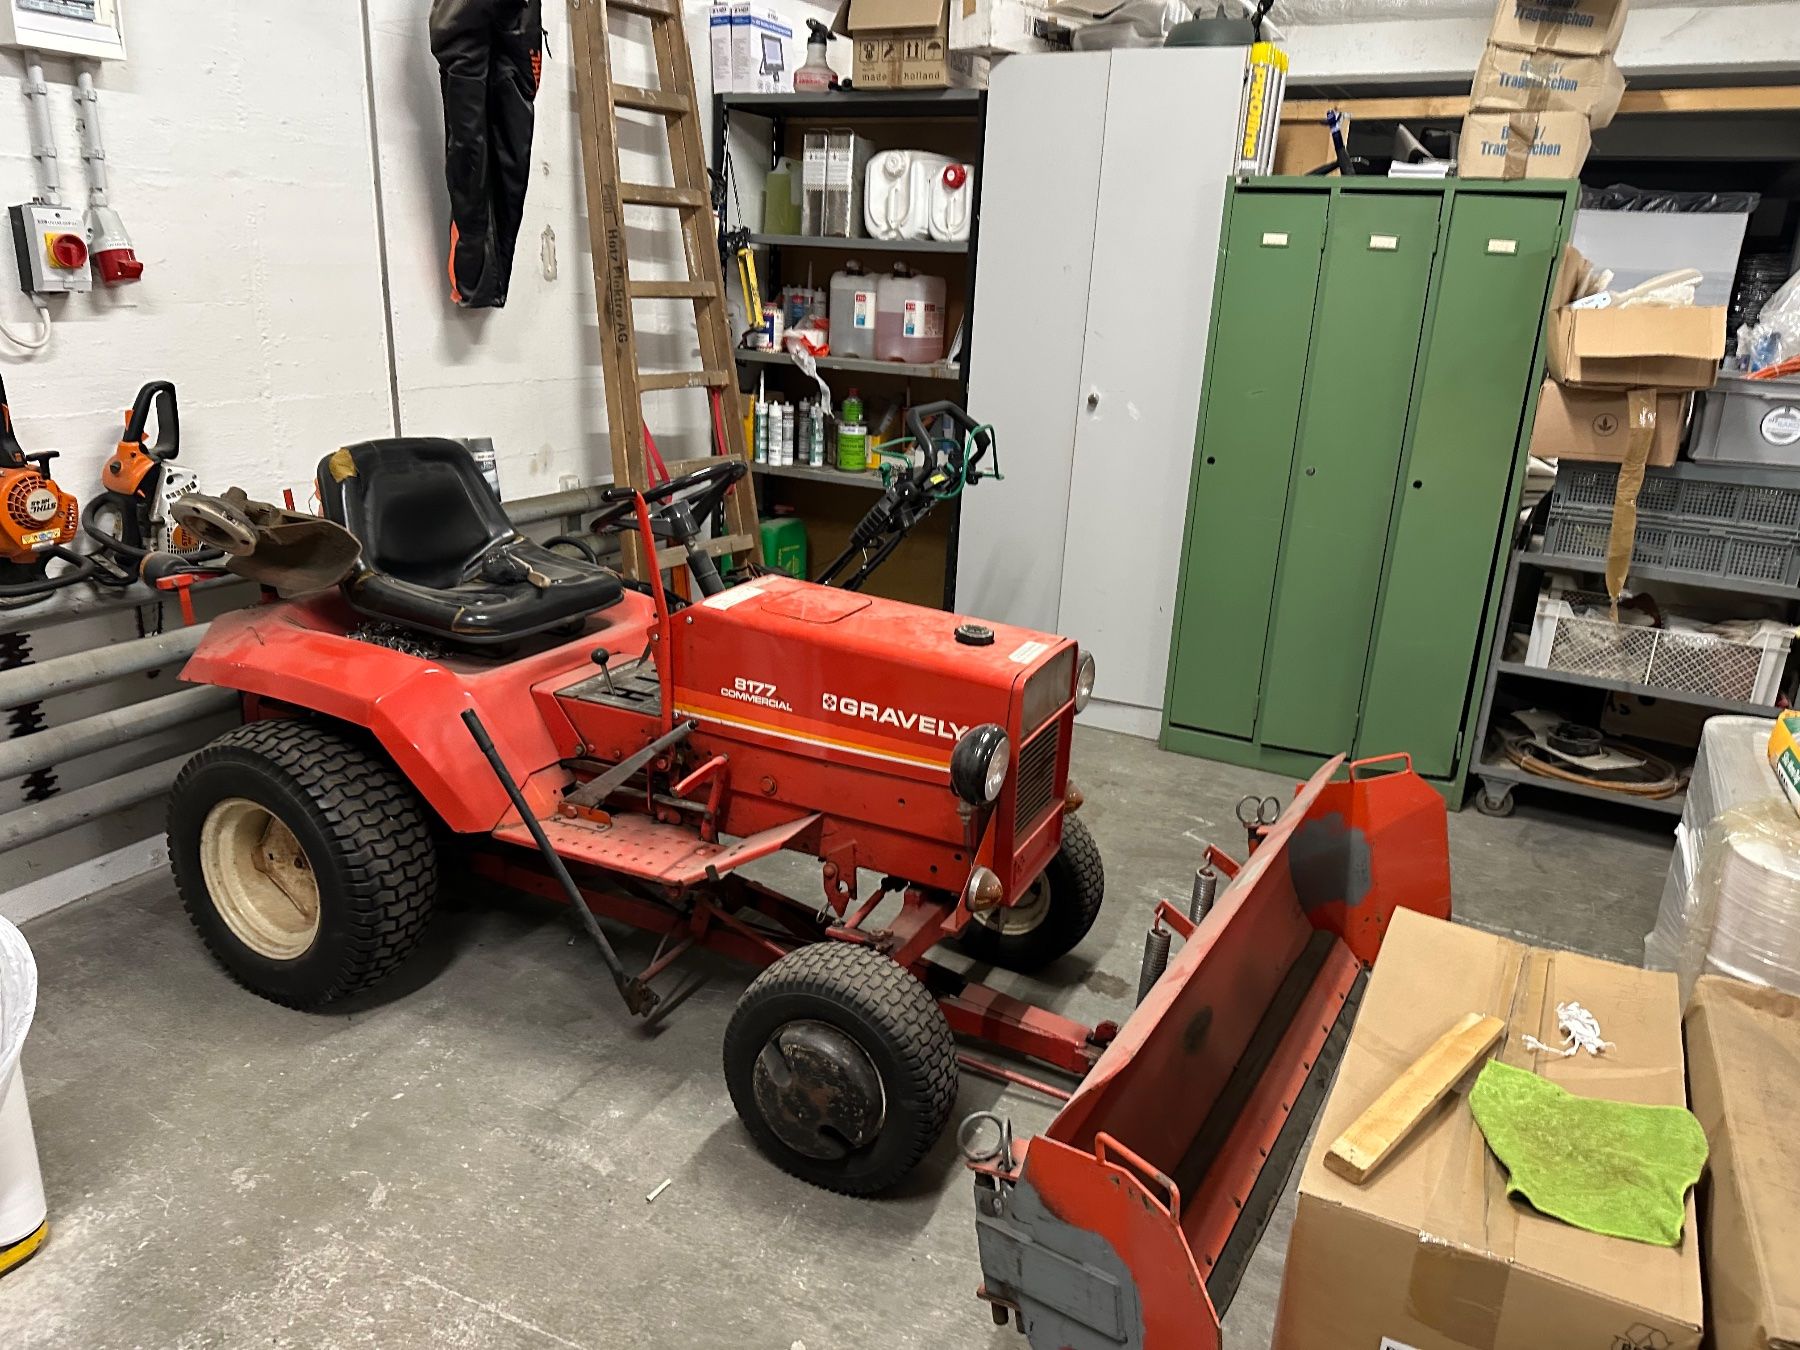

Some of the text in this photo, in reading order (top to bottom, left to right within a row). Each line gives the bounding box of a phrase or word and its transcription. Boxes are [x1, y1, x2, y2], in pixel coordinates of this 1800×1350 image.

[862, 72, 887, 81] made
[904, 71, 940, 80] holland
[612, 265, 625, 318] Elektro
[616, 323, 629, 344] AG
[735, 677, 776, 697] 8177
[721, 687, 793, 712] COMMERCIAL
[840, 698, 969, 741] GRAVELY
